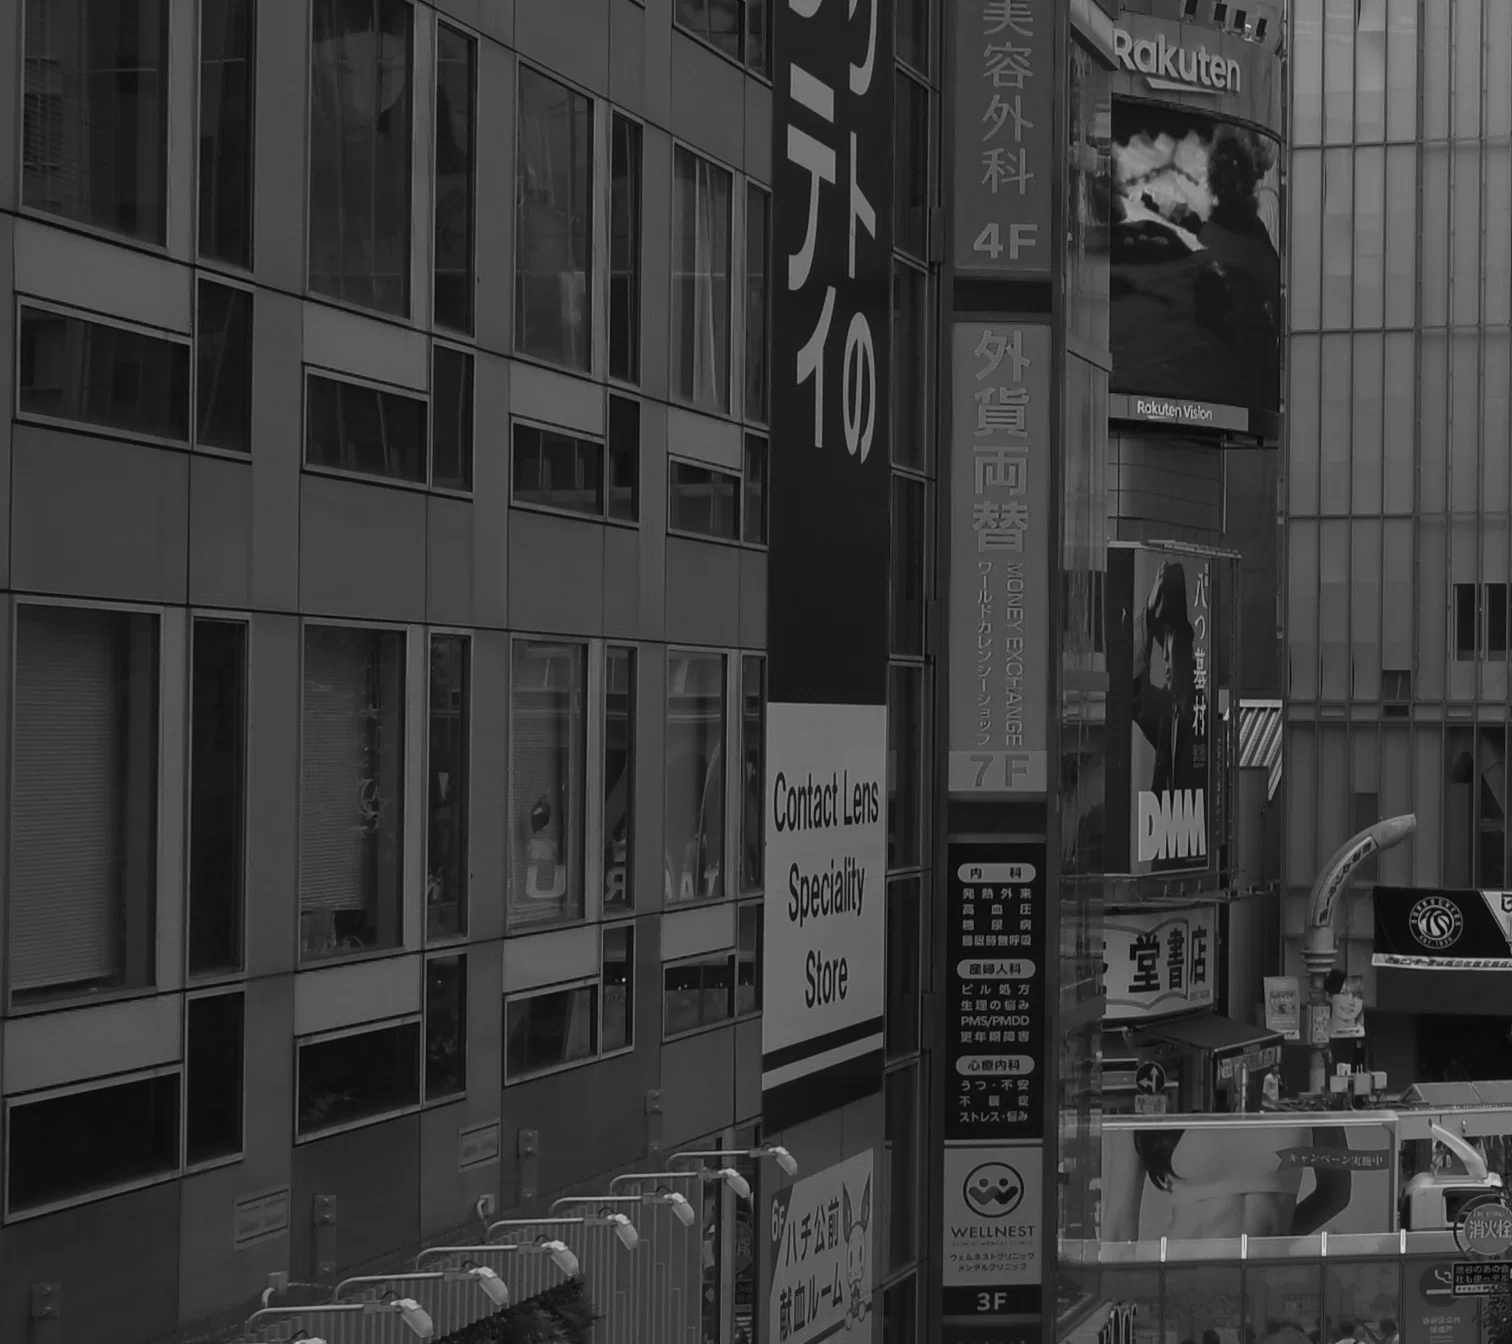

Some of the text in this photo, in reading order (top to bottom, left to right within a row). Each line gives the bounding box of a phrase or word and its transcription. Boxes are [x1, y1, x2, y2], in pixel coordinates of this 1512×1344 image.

[1113, 28, 1241, 92] Rakuten
[973, 223, 1038, 261] 4F
[1137, 399, 1212, 421] Rakuten Vision
[973, 330, 1030, 552] 外貨両替
[1006, 562, 1023, 747] MONEY EXCHANGE
[774, 769, 879, 832] Contact Lens
[969, 754, 1029, 788] 7F
[1138, 788, 1207, 862] DMM
[788, 863, 865, 927] Speciality
[963, 887, 1032, 901] 発熱外来
[970, 867, 1022, 880] 内科
[805, 949, 848, 1008] Store
[961, 1016, 1030, 1027] PMS/PMDD
[785, 1193, 841, 1268] ハチ公前
[950, 1224, 1035, 1240] WELLNEST
[778, 1263, 843, 1342] 献血ルーム
[976, 1292, 1007, 1312] 3F
